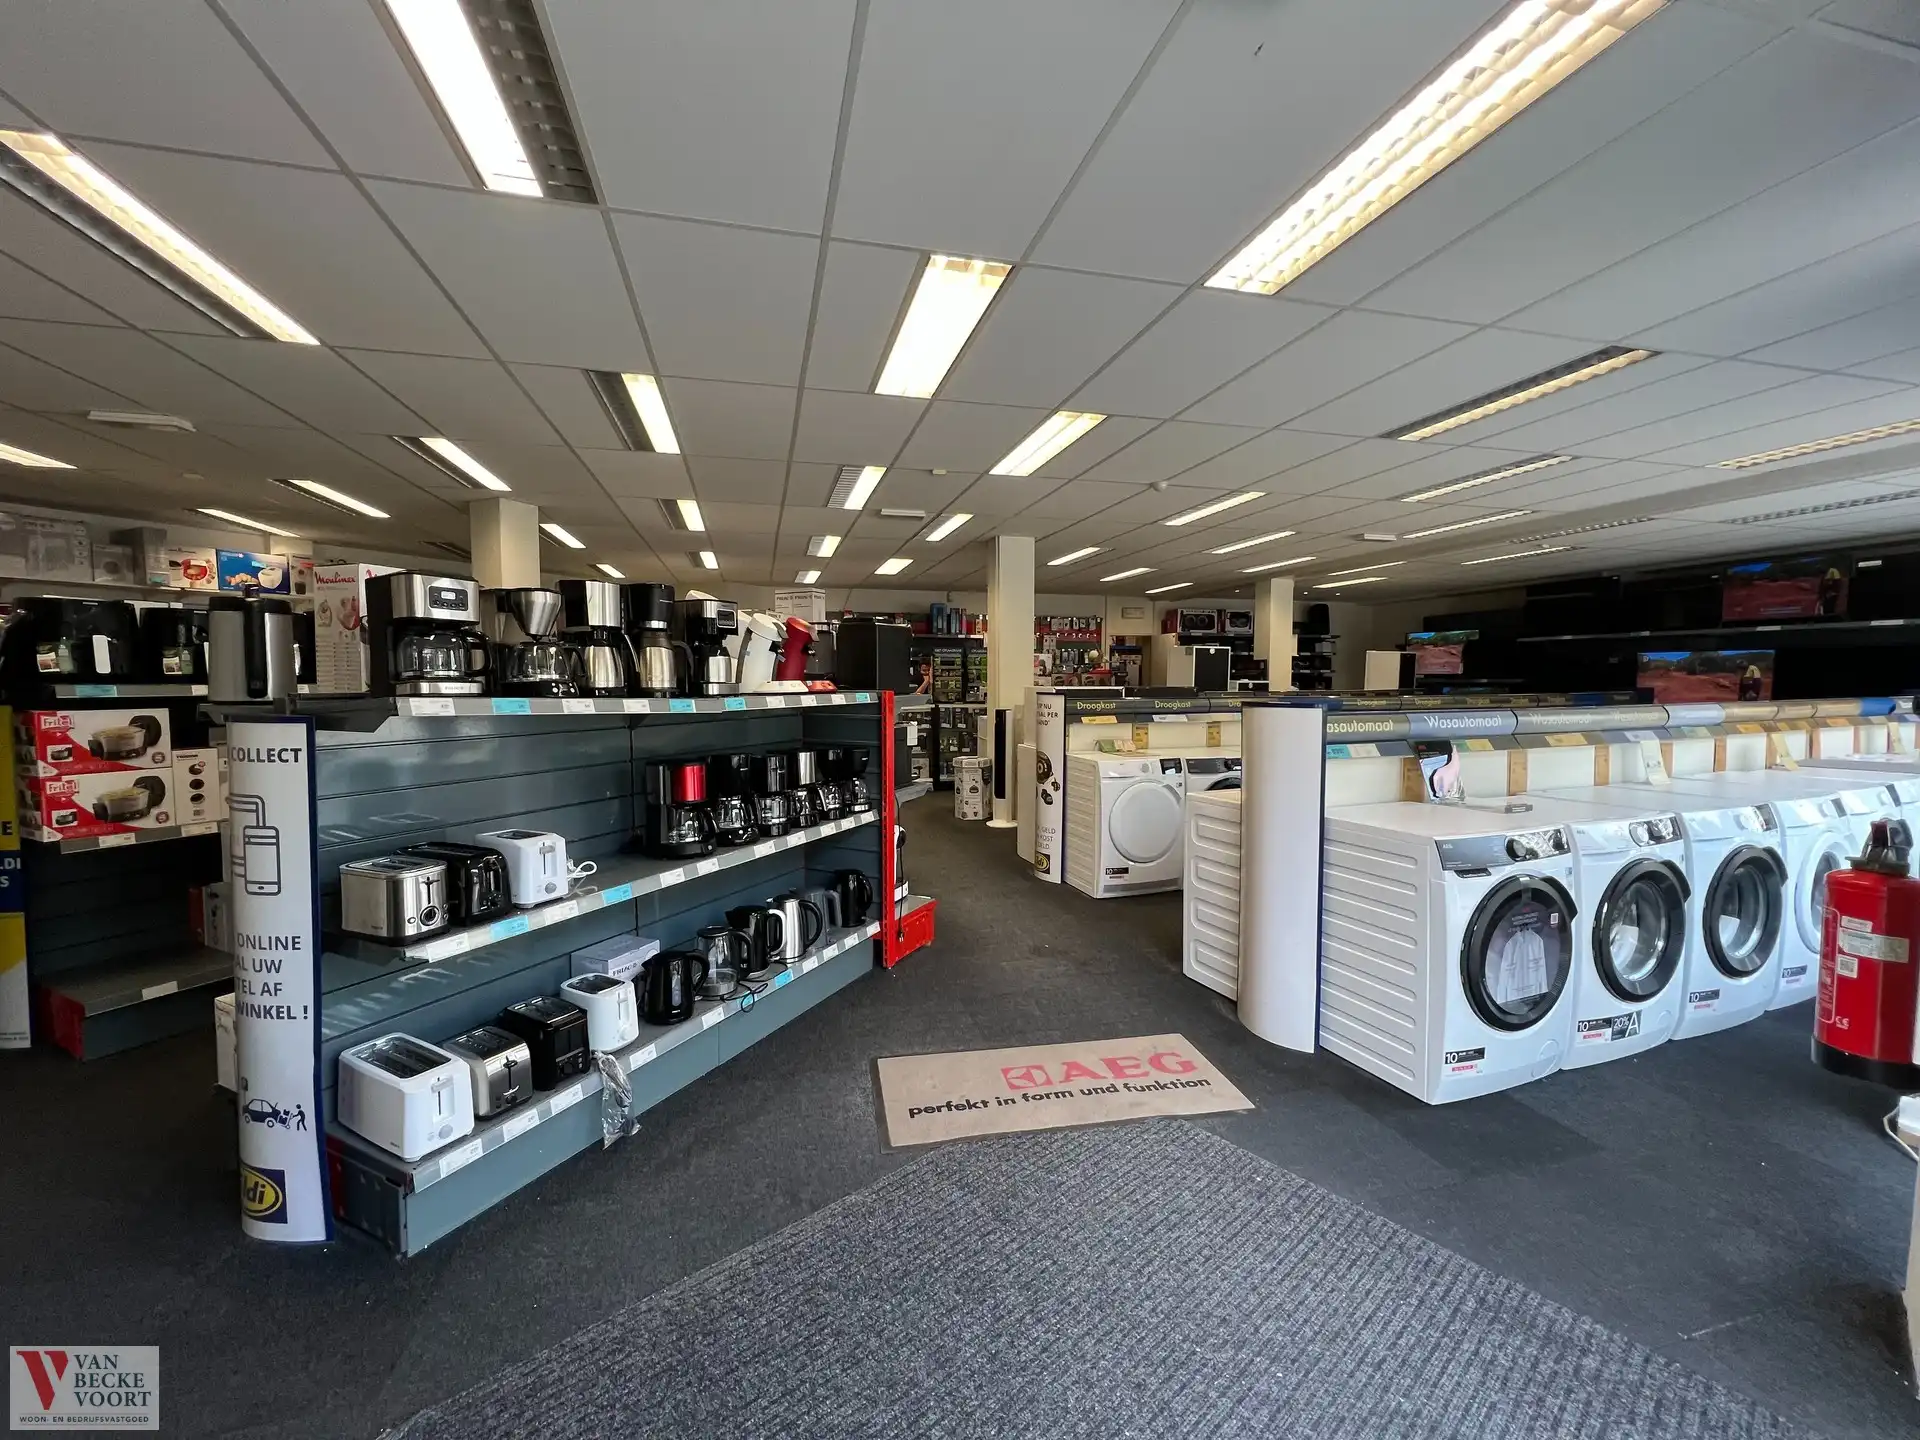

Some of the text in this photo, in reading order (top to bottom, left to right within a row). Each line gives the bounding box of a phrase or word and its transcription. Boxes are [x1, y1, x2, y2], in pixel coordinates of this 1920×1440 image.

[314, 571, 357, 585] Moulinex
[1076, 701, 1117, 712] Droogkast
[1154, 700, 1192, 711] Droogkast
[1047, 711, 1059, 719] PER
[1423, 714, 1502, 729] Wasautomaat
[231, 747, 302, 763] COLLECT
[237, 933, 301, 951] ONLINE
[252, 958, 283, 974] UW
[260, 981, 283, 997] AF
[1690, 992, 1700, 1002] 10
[1577, 1020, 1588, 1032] 10
[1612, 1016, 1630, 1029] 20%
[1445, 1052, 1458, 1064] 10
[1059, 1051, 1198, 1083] AEG
[908, 1077, 1212, 1119] perfekt in form und funktion
